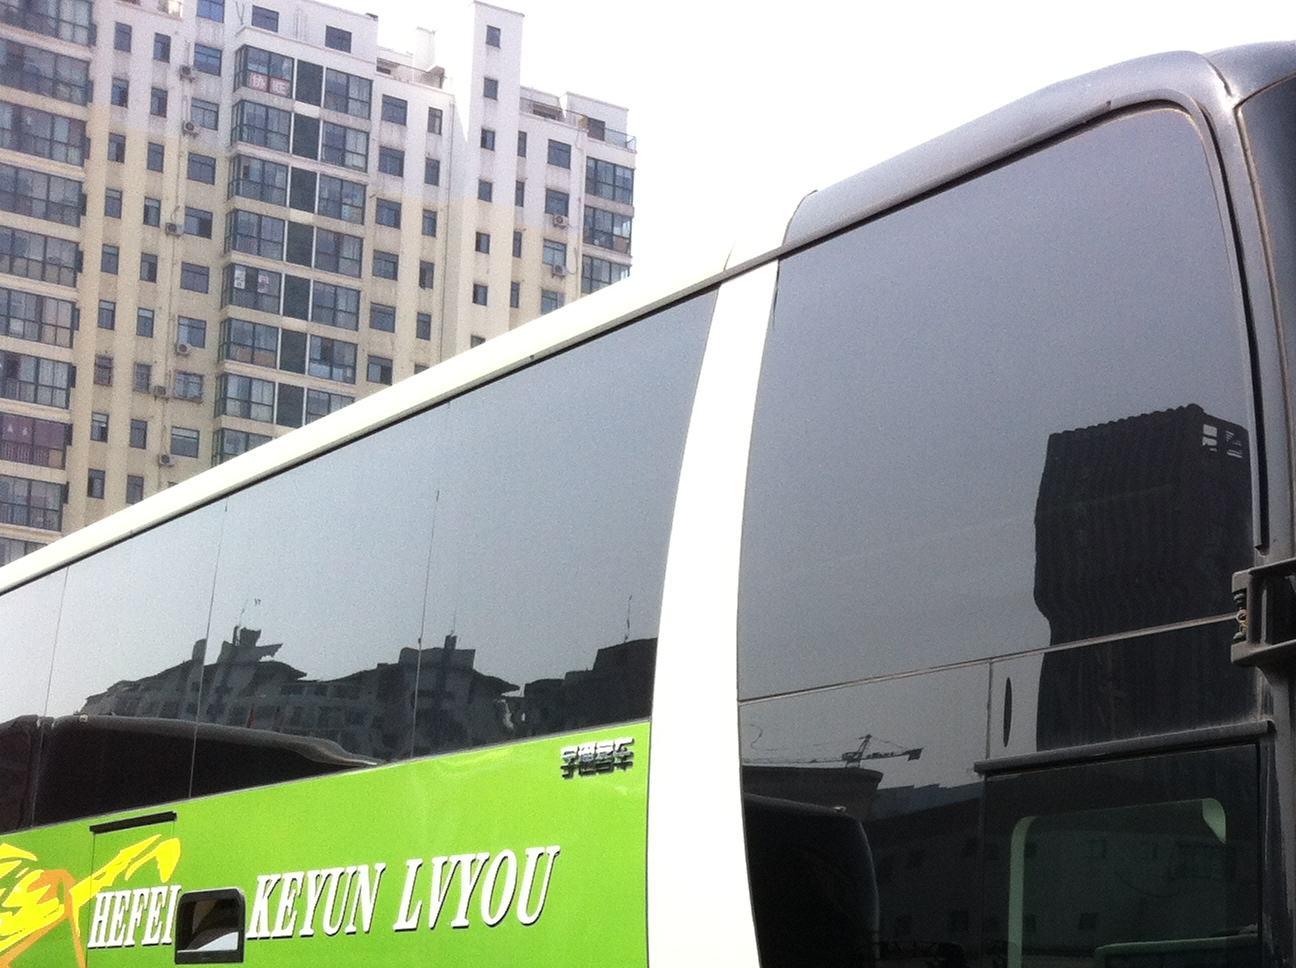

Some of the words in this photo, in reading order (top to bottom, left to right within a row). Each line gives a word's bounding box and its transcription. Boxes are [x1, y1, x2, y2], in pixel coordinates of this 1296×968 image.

[88, 886, 182, 948] HEFEI
[245, 863, 386, 940] KEYUN
[393, 845, 560, 932] LVYOU
